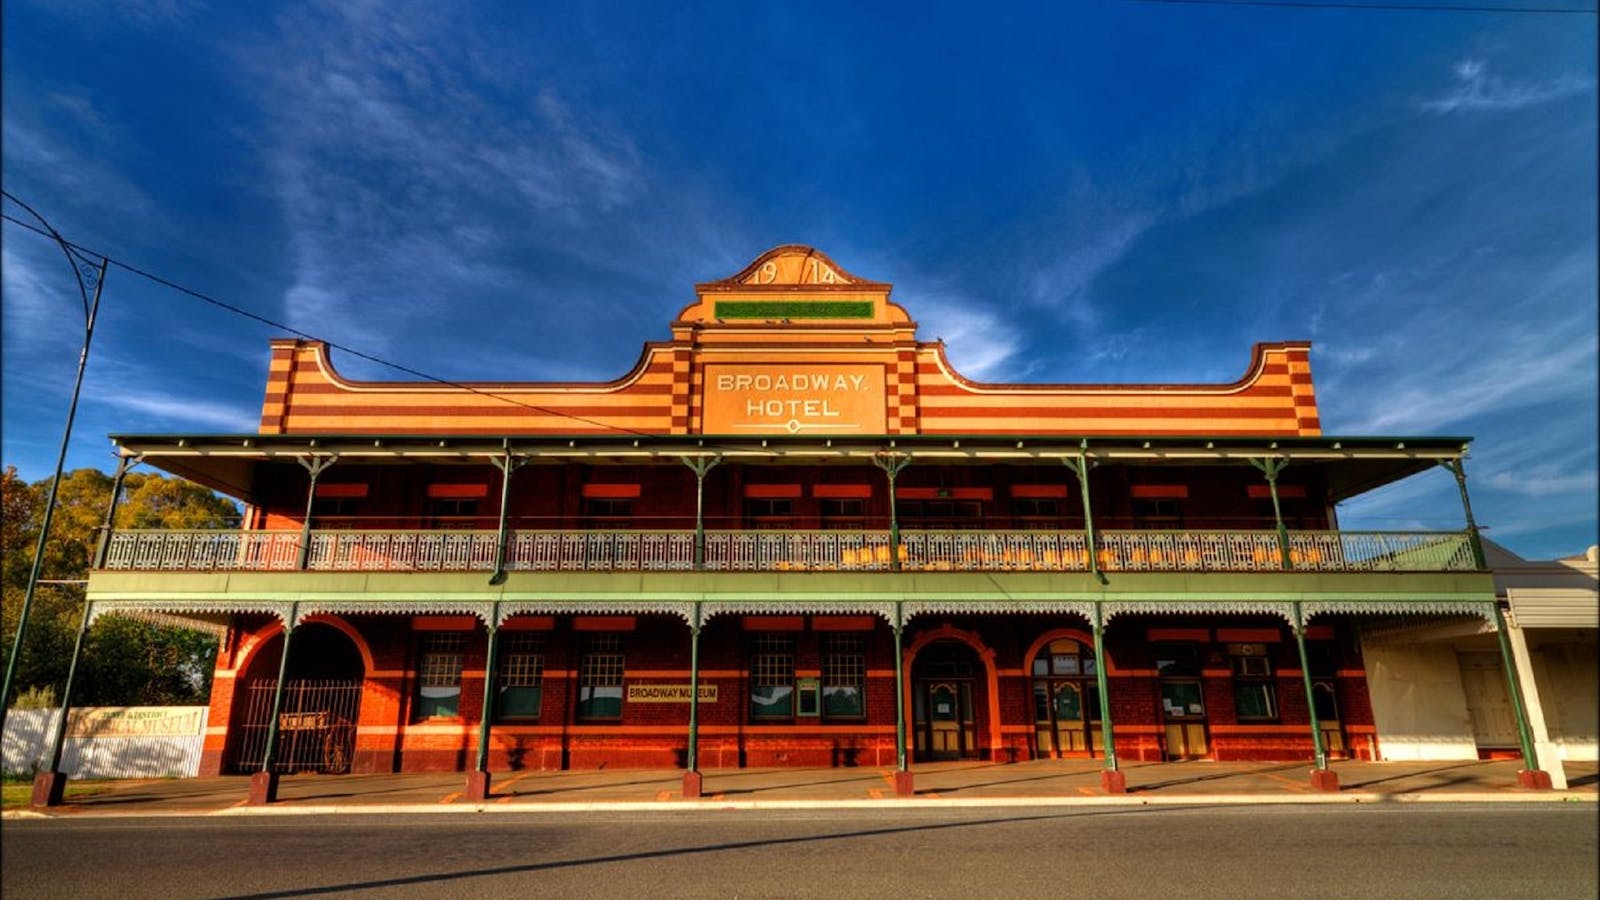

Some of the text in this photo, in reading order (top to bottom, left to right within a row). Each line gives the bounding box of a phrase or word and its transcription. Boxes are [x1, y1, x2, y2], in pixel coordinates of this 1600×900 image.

[746, 399, 841, 417] HOTEL
[629, 688, 717, 698] BROADWAY MUEUM
